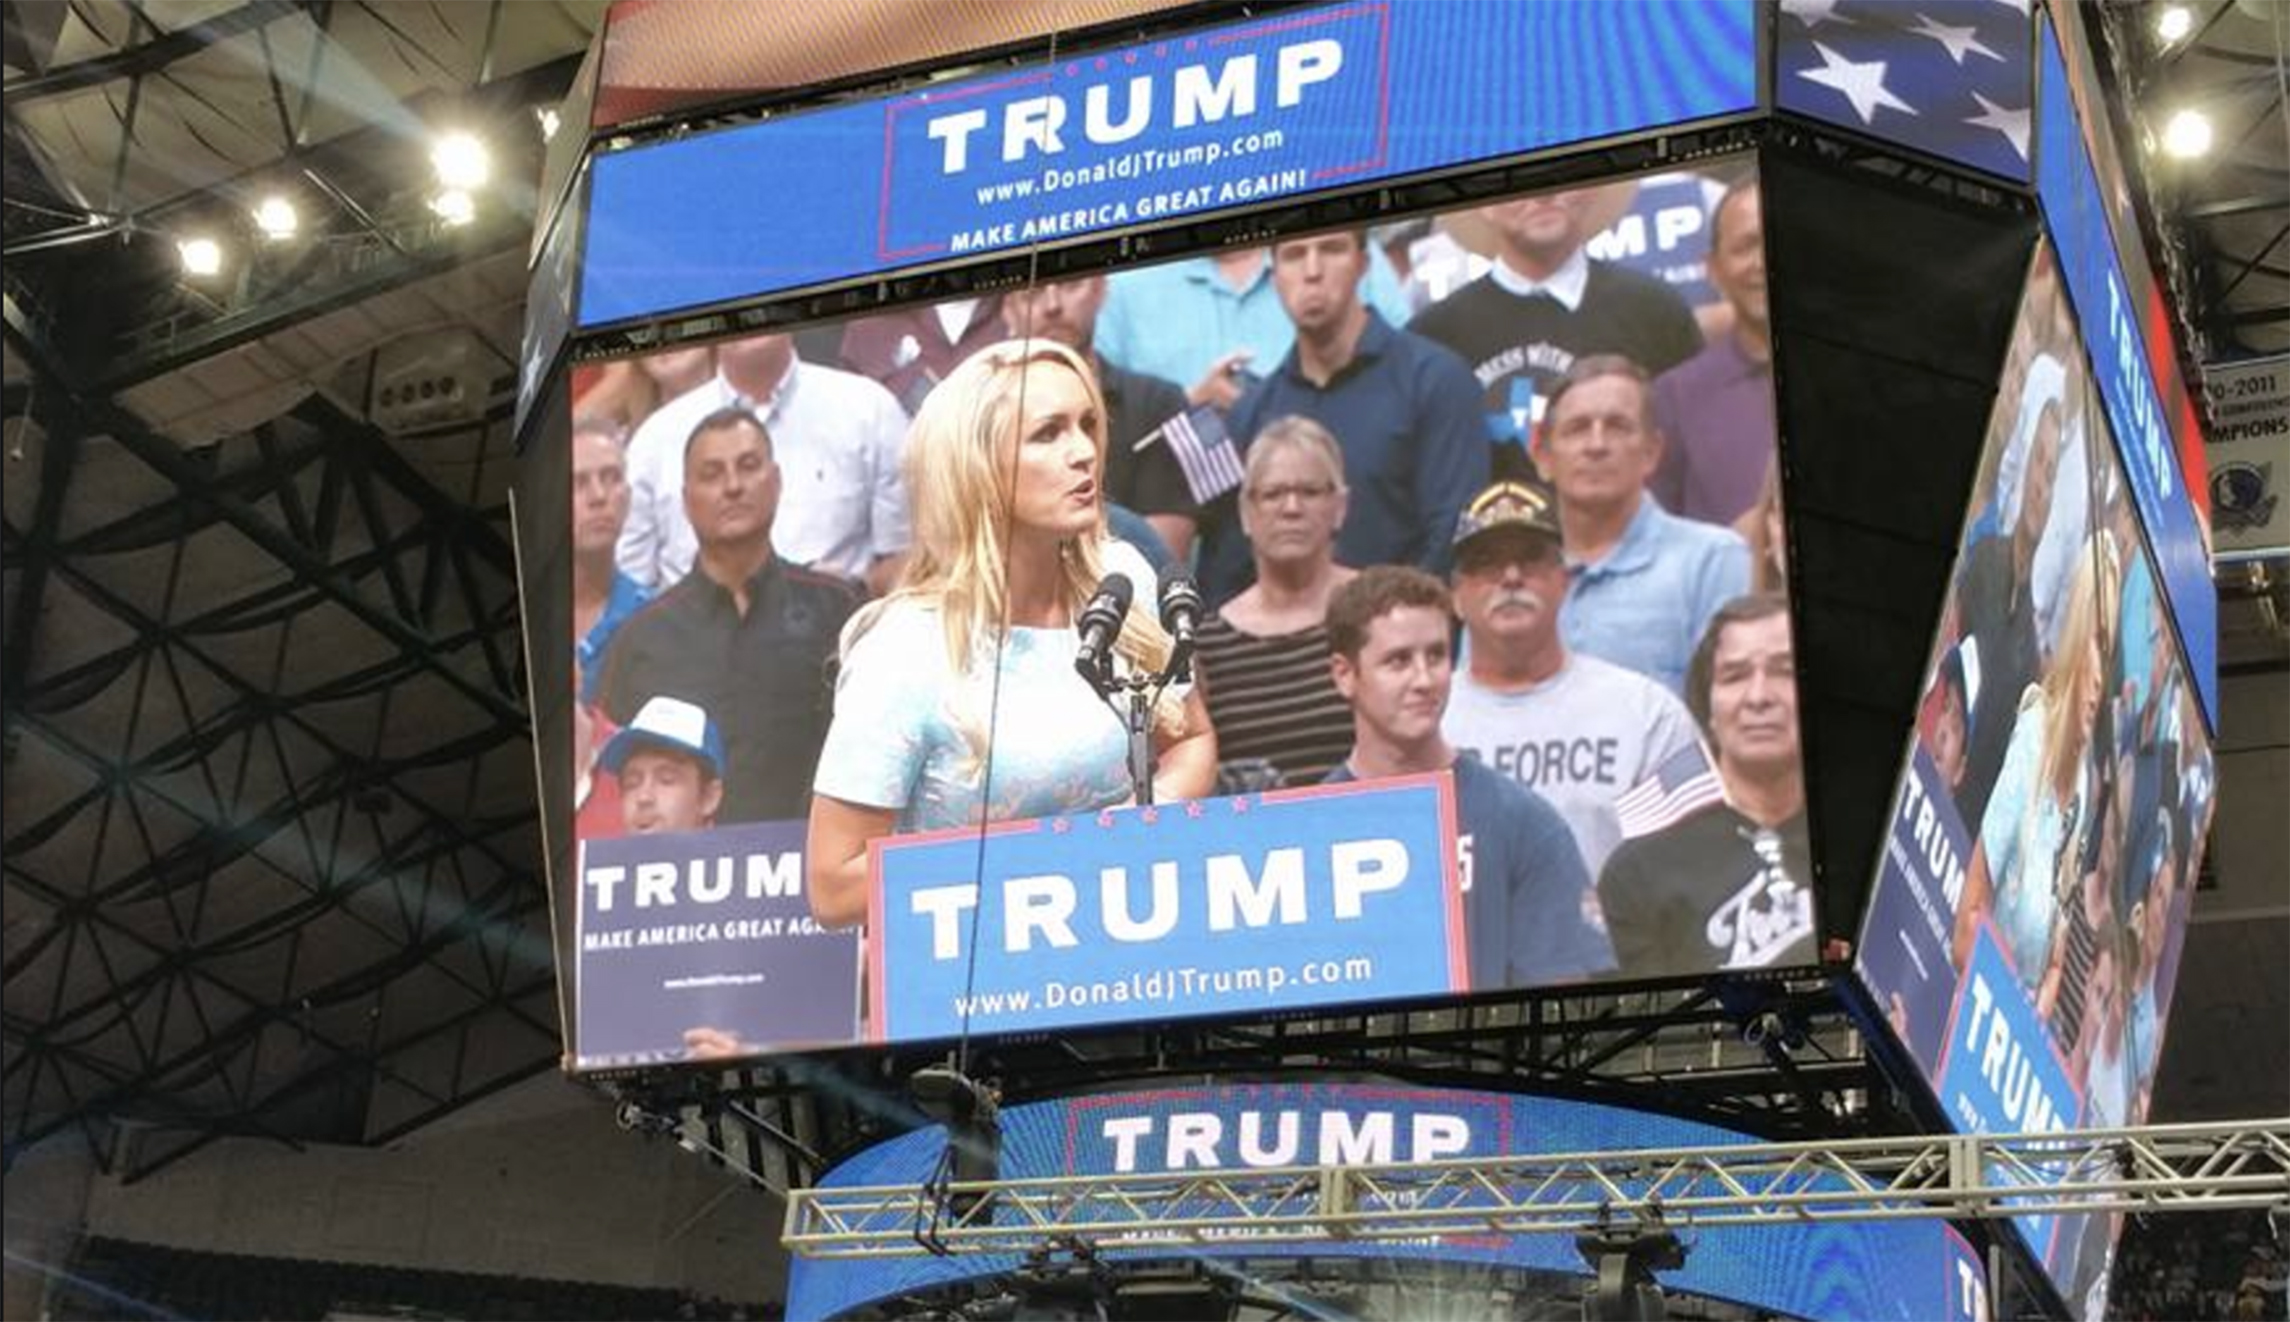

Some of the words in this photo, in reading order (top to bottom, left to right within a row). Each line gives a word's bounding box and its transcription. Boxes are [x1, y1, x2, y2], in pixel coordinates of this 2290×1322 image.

[927, 37, 1344, 174] TRUMP
[976, 129, 1284, 206] www.DonaldJTrump.com
[951, 220, 1016, 253] MAKE
[1021, 191, 1130, 241] AMERICA
[1136, 186, 1214, 217] GREAT
[1219, 168, 1307, 202] AGAIN!
[2107, 268, 2172, 501] TRUMP
[2208, 415, 2289, 444] MPIONS
[1495, 737, 1618, 788] FORCE
[1904, 769, 1966, 916] TRUM
[586, 852, 802, 911] TRUM
[910, 838, 1410, 960] TRUMP
[584, 931, 633, 950] MAKE
[637, 922, 720, 947] AMERICA
[723, 919, 784, 940] GREAT
[953, 955, 1373, 1019] www.DonaldJTrump.com
[1103, 1111, 1471, 1172] TRUMP
